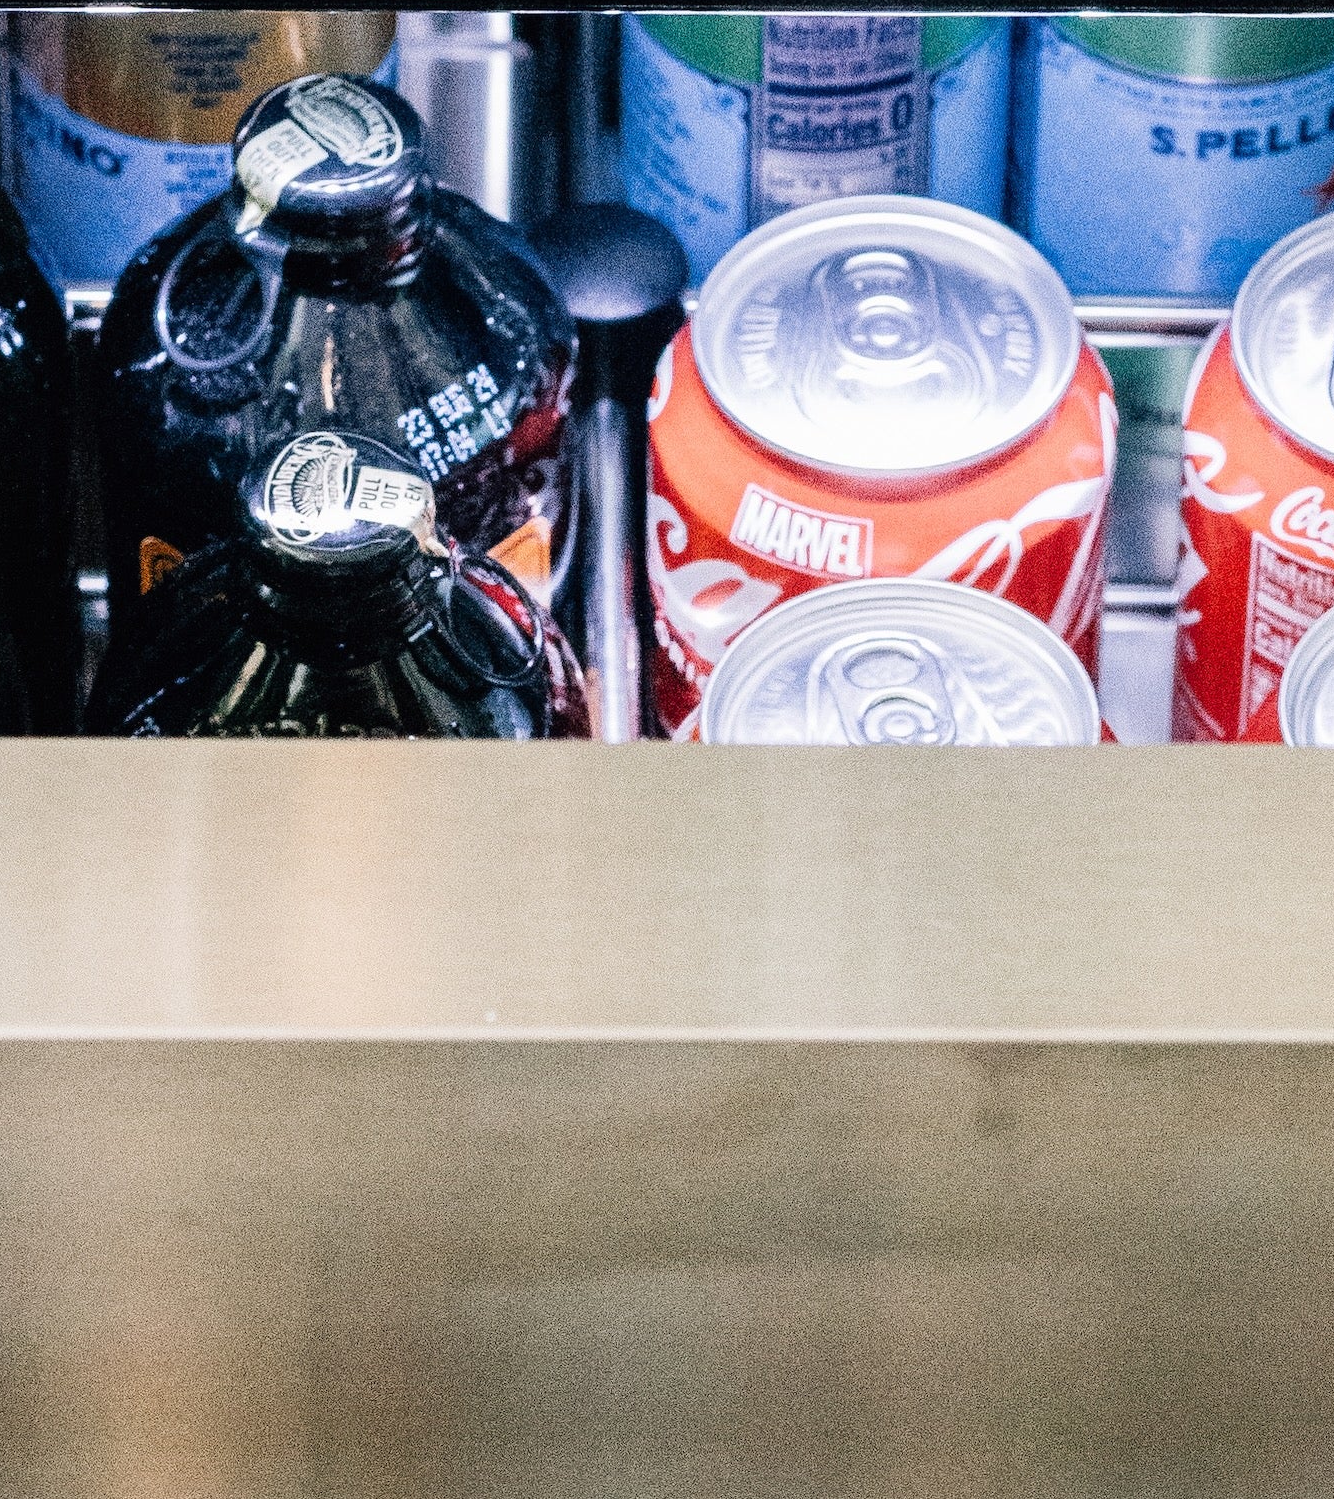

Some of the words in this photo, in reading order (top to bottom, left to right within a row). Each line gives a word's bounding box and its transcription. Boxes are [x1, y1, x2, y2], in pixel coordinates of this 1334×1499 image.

[890, 91, 915, 132] 0
[359, 477, 382, 511] PULL
[735, 501, 866, 578] MARVEL
